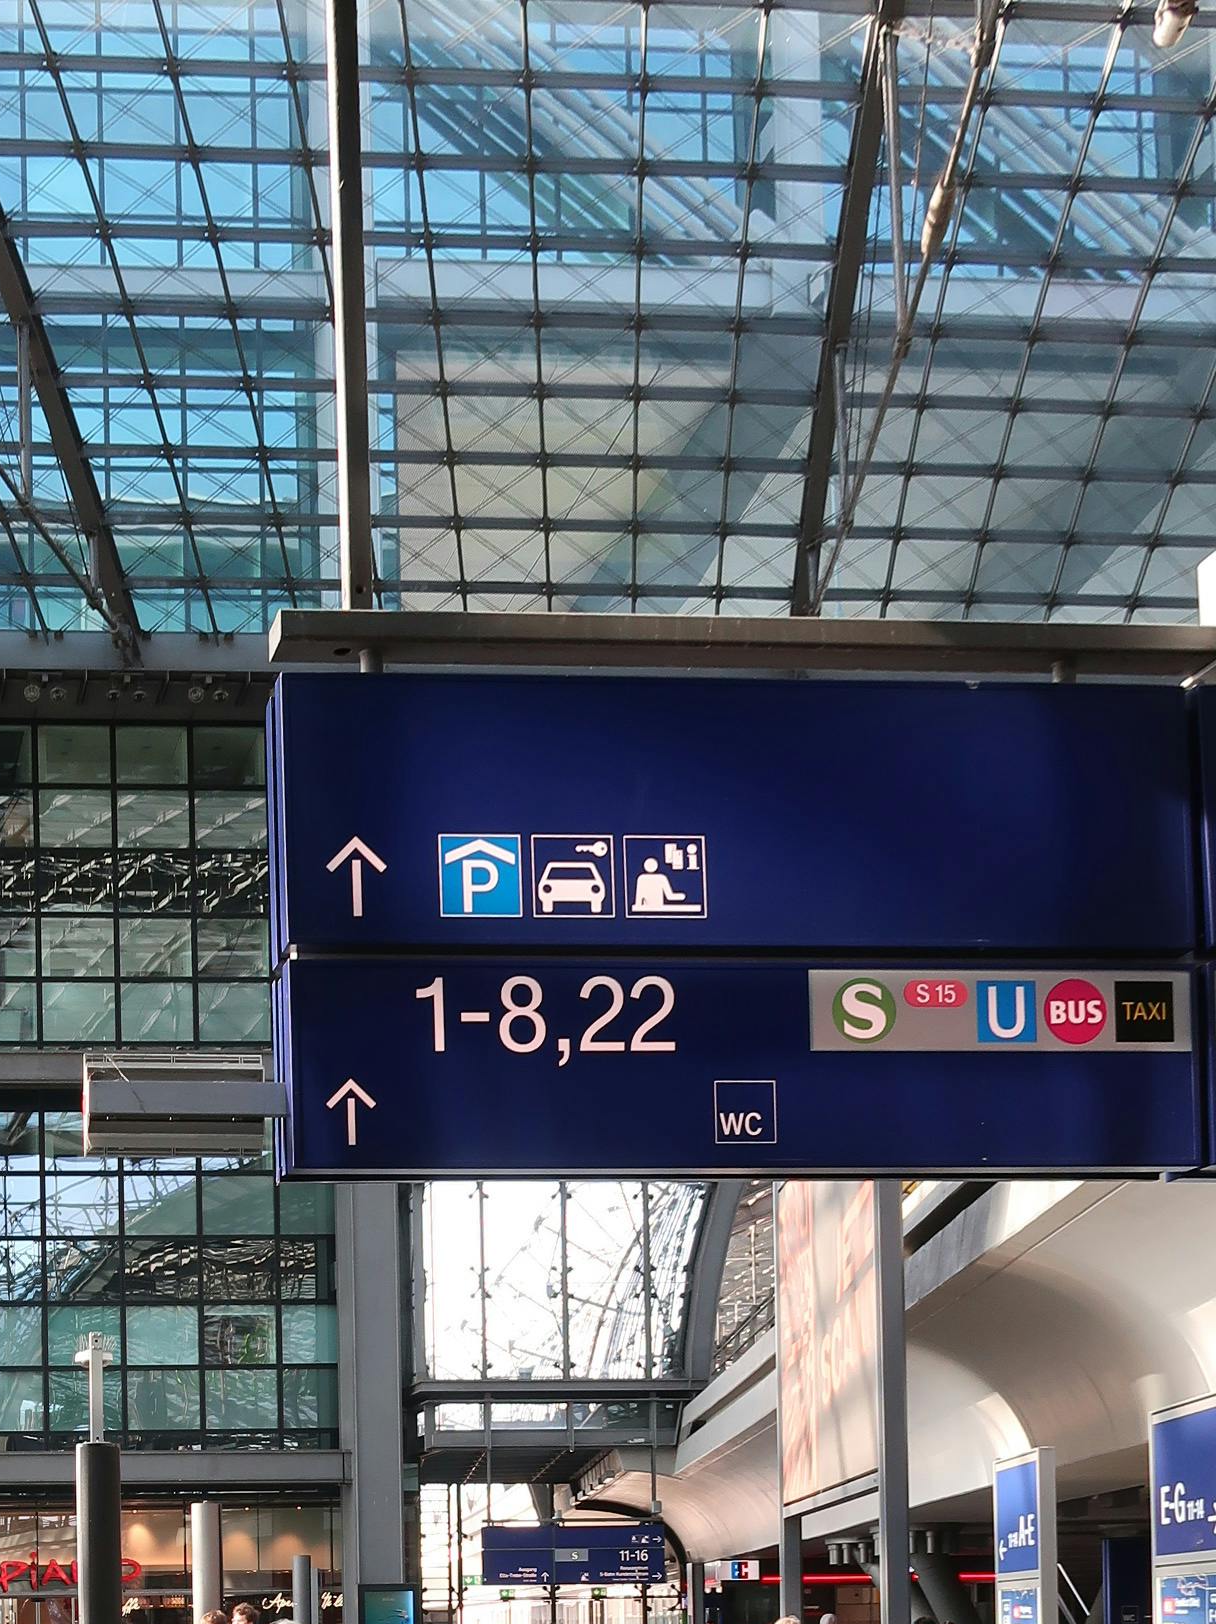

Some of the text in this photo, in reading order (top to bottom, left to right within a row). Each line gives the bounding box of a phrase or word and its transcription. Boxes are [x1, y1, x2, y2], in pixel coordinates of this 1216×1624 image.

[462, 859, 499, 913] P
[916, 984, 957, 1003] S 15
[416, 975, 676, 1067] 1-8,22
[840, 983, 887, 1039] S
[987, 985, 1025, 1039] U
[1049, 999, 1104, 1025] BUS
[1122, 1002, 1167, 1022] TAXI
[719, 1112, 763, 1136] WC
[618, 1549, 649, 1561] 11-16
